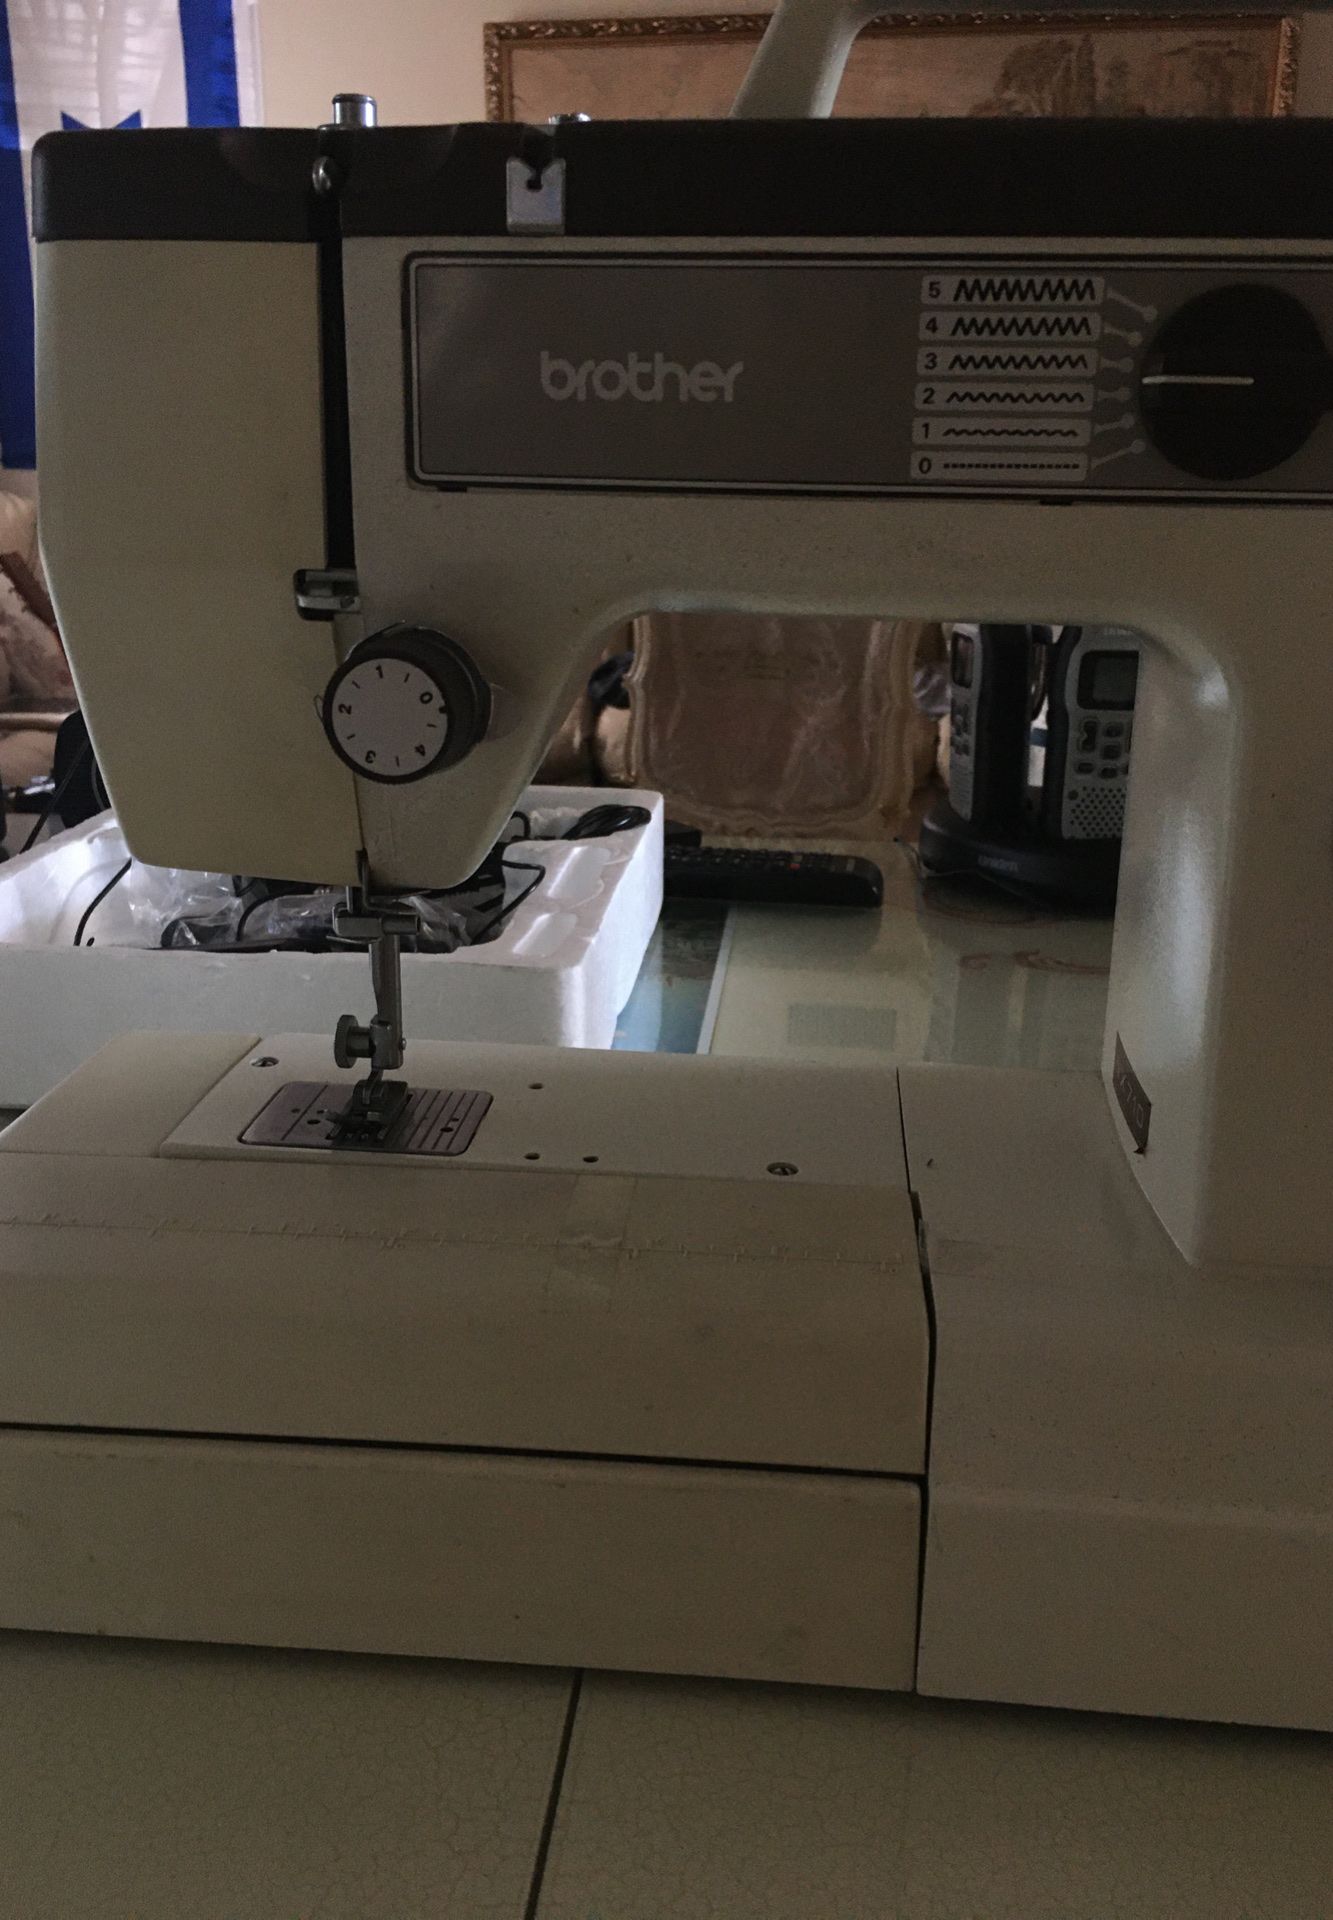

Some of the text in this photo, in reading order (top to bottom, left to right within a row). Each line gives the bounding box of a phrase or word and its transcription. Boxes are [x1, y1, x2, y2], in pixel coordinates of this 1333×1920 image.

[928, 281, 941, 299] 5
[925, 317, 939, 333] 4
[924, 352, 938, 370] 3
[540, 351, 744, 402] brother
[922, 387, 936, 404] 2
[921, 423, 930, 439] 1
[918, 457, 932, 474] 0
[375, 665, 384, 679] 1
[419, 691, 433, 705] 0
[338, 703, 352, 715] 2
[364, 750, 377, 764] 3
[414, 744, 426, 757] 4
